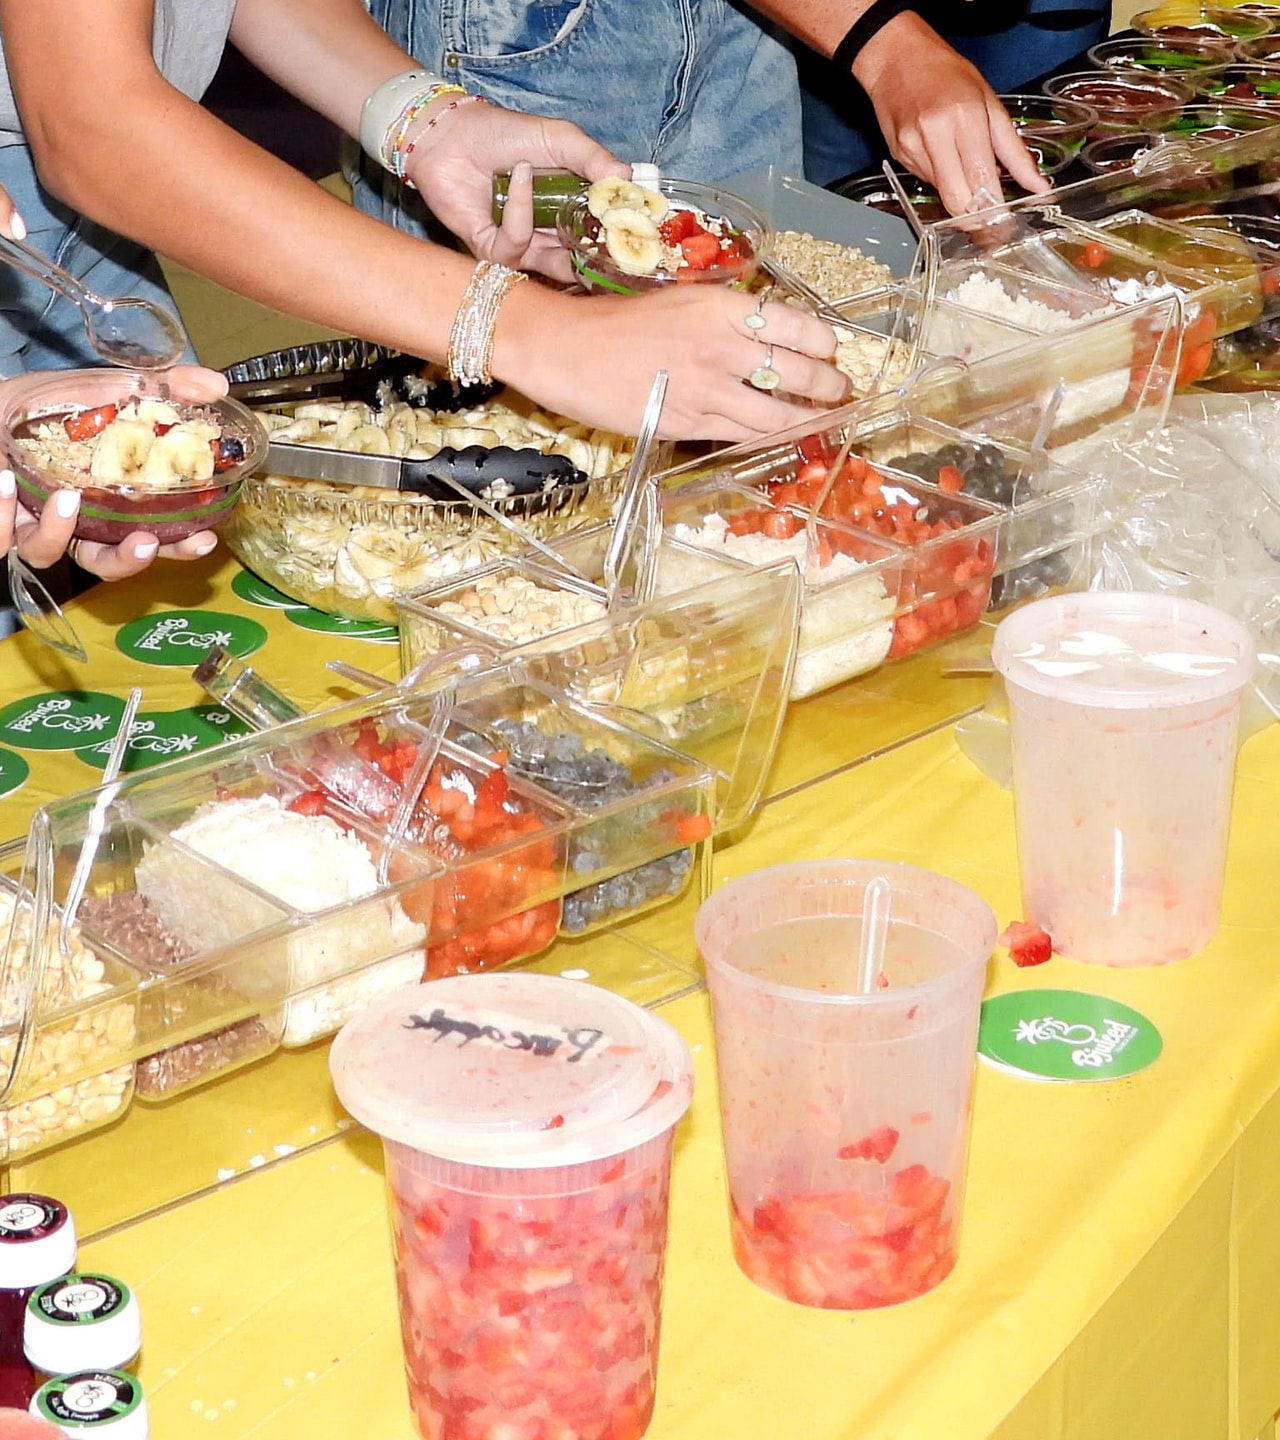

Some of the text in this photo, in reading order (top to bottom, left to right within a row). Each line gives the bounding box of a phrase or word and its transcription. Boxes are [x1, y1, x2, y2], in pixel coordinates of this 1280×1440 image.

[140, 618, 189, 650] Bjuiced
[10, 699, 72, 733] Bjuiced
[1071, 1018, 1132, 1067] Bjuiced
